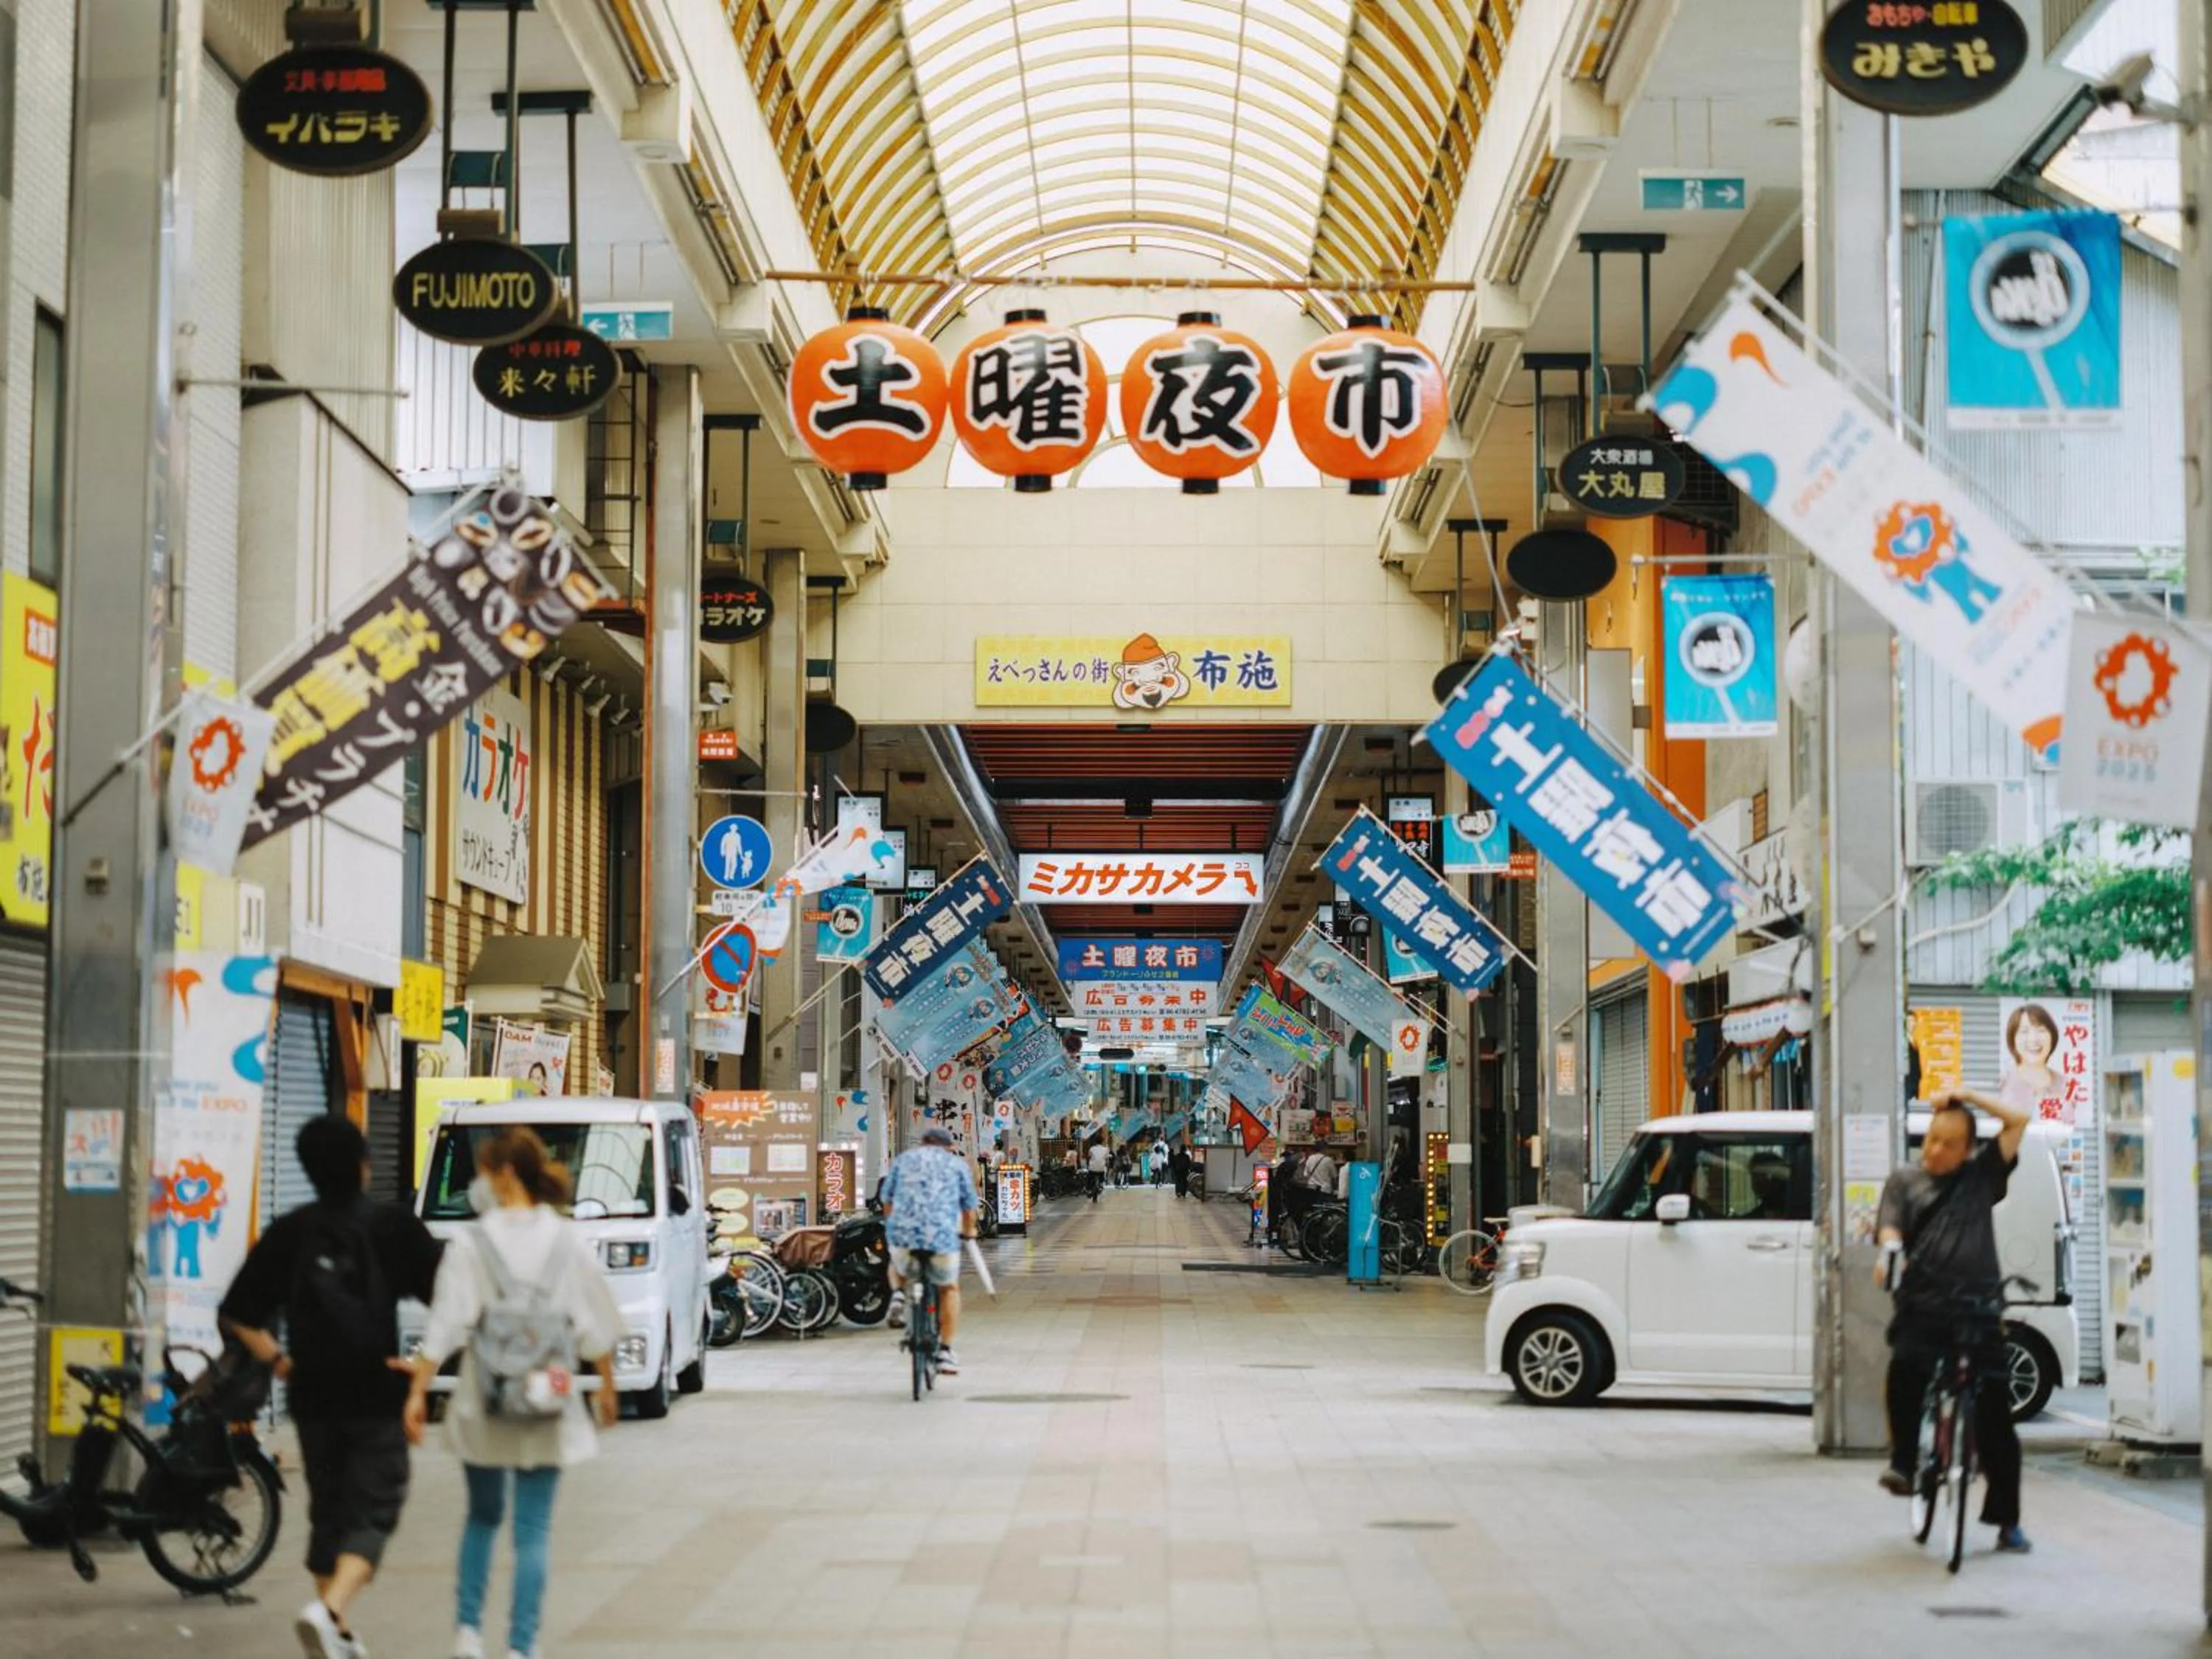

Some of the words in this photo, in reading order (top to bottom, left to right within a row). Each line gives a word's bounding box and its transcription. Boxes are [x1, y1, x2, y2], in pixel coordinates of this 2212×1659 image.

[1852, 38, 1996, 78] みきや
[412, 271, 536, 308] FUJIMOTO
[498, 365, 597, 398] 来々軒
[813, 335, 1428, 453] 土曜夜市
[1590, 448, 1653, 465] 大衆酒場
[1578, 470, 1666, 499] 大丸屋
[701, 606, 766, 626] ラオケ
[987, 658, 1109, 684] えべっさんの街
[1194, 650, 1279, 692] 布施
[464, 703, 529, 820] カラオケ
[1027, 862, 1228, 895] ミカサカメラ
[875, 891, 985, 988] 土曜夜市
[1081, 944, 1199, 967] 土曜夜市
[1096, 1017, 1197, 1032] 広告募集中
[2063, 1023, 2089, 1102] やはた
